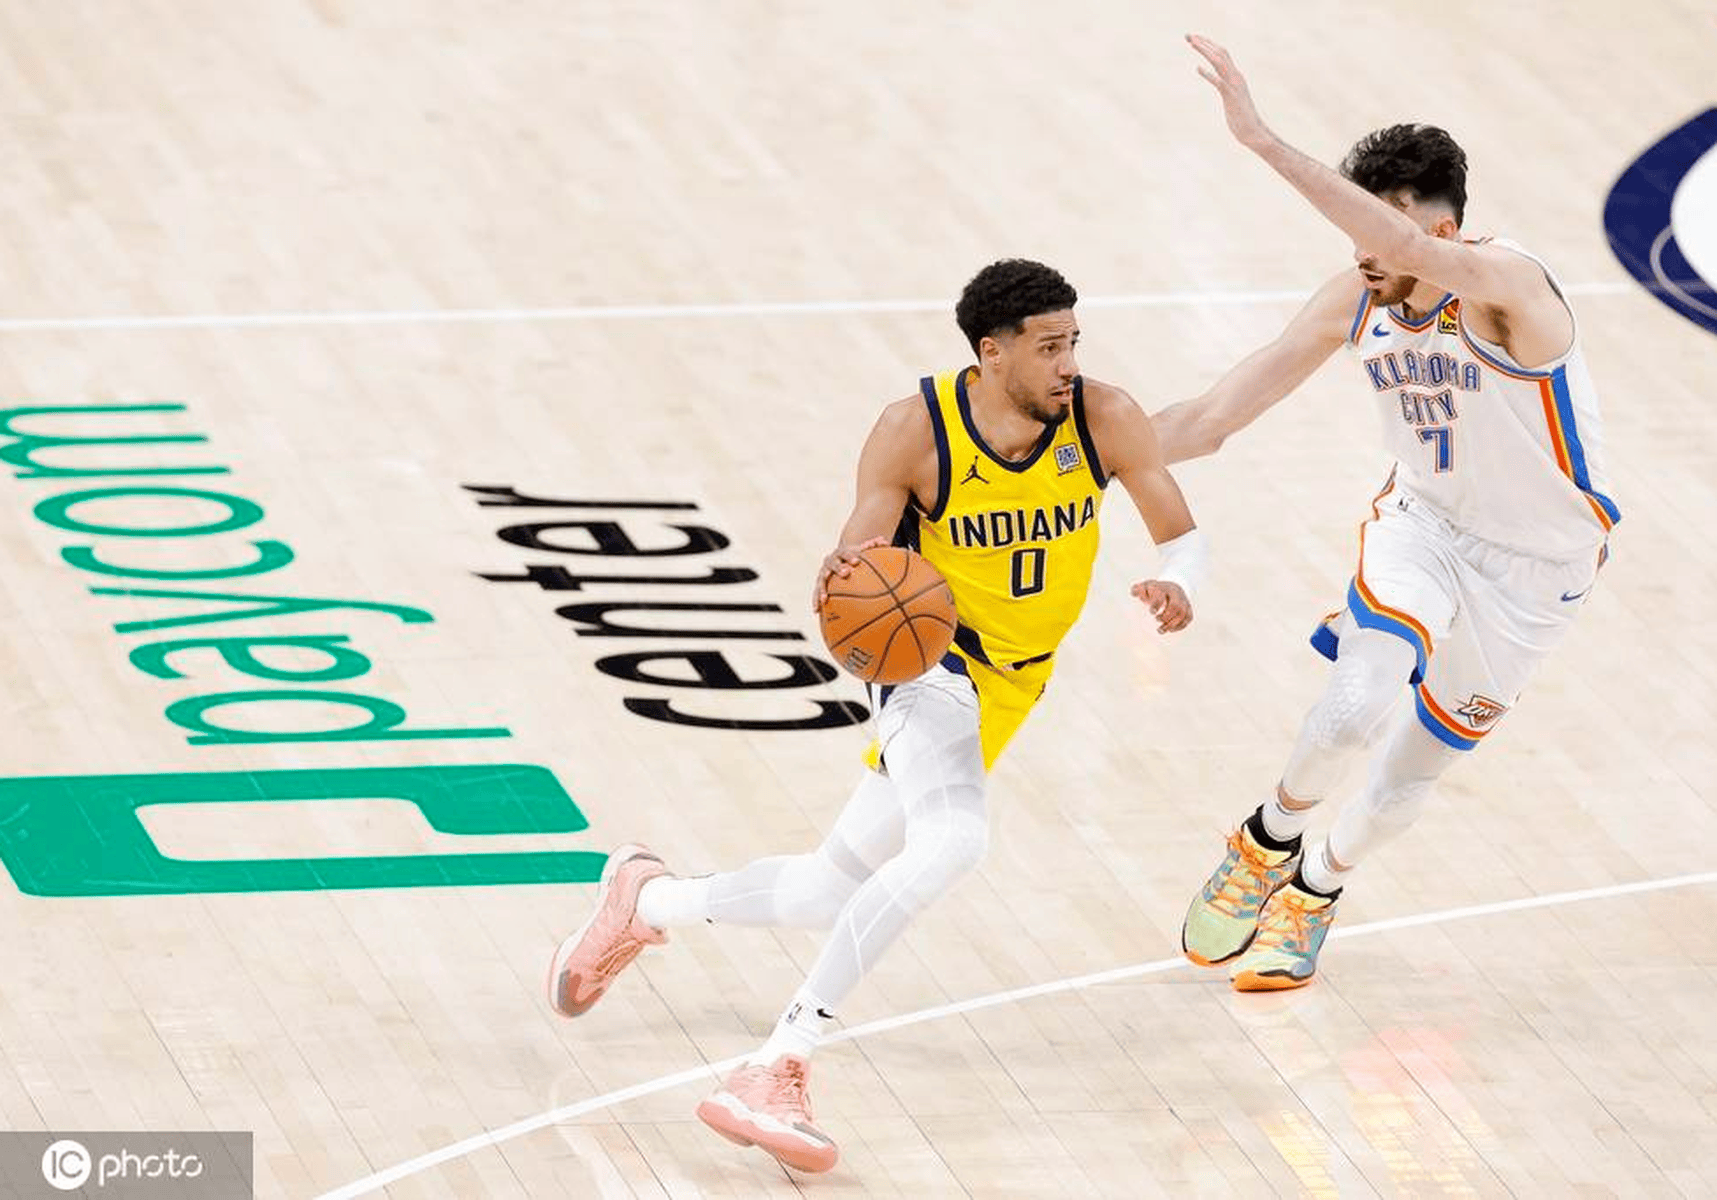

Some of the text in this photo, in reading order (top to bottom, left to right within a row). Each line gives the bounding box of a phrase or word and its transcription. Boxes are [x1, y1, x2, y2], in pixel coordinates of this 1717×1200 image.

[1363, 349, 1481, 393] KLAOMA
[1400, 388, 1459, 426] CITY
[1415, 426, 1454, 474] 7
[949, 495, 1096, 549] INDIANA
[0, 403, 513, 746] paycom
[1009, 547, 1047, 599] 0
[459, 483, 871, 731] center
